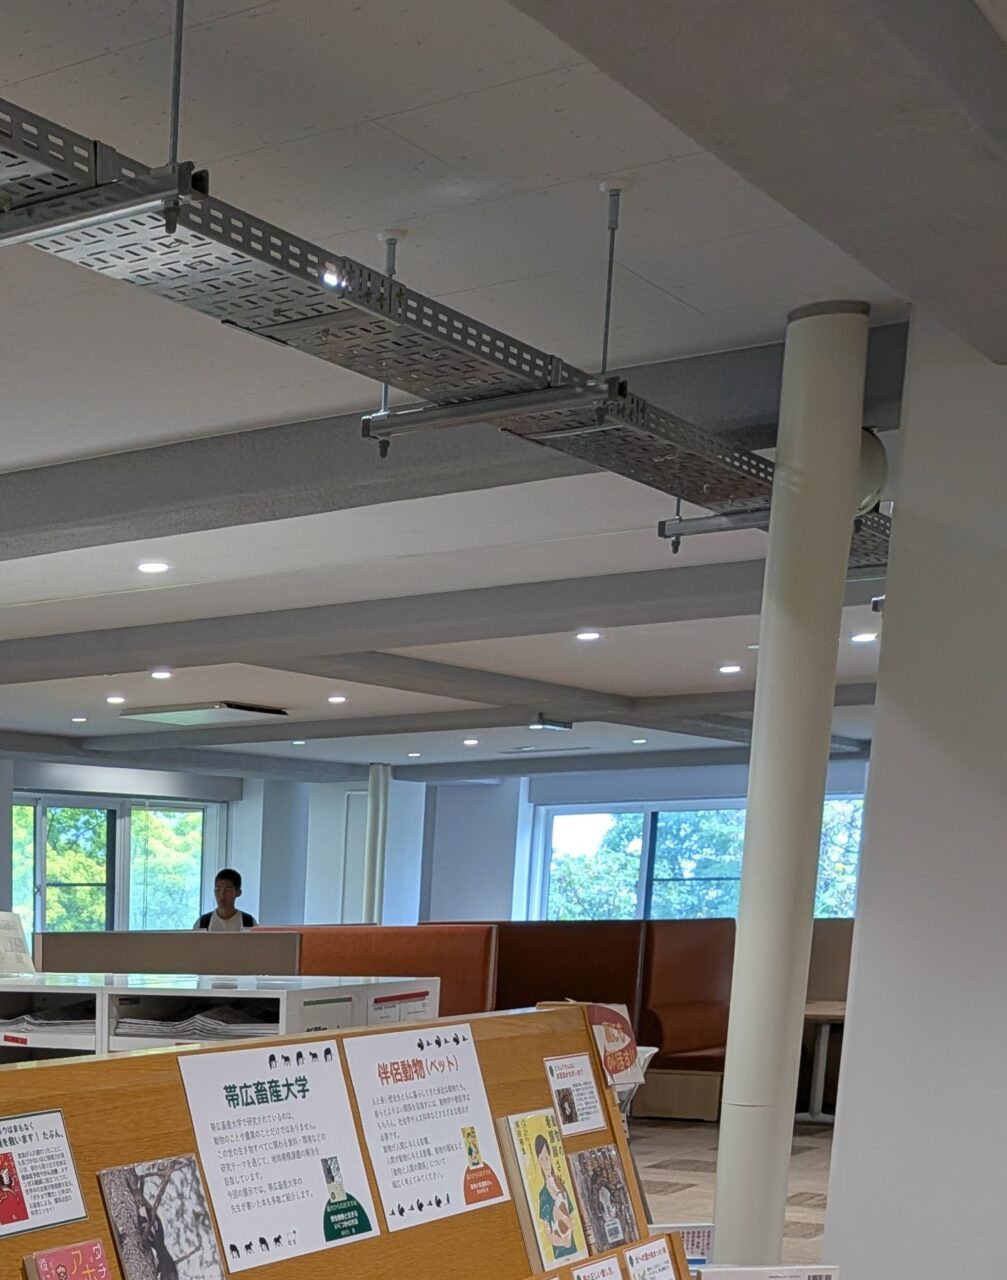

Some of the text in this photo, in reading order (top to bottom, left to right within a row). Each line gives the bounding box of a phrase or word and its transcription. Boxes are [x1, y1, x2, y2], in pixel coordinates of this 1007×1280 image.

[223, 1075, 310, 1109] 帯広畜産大学
